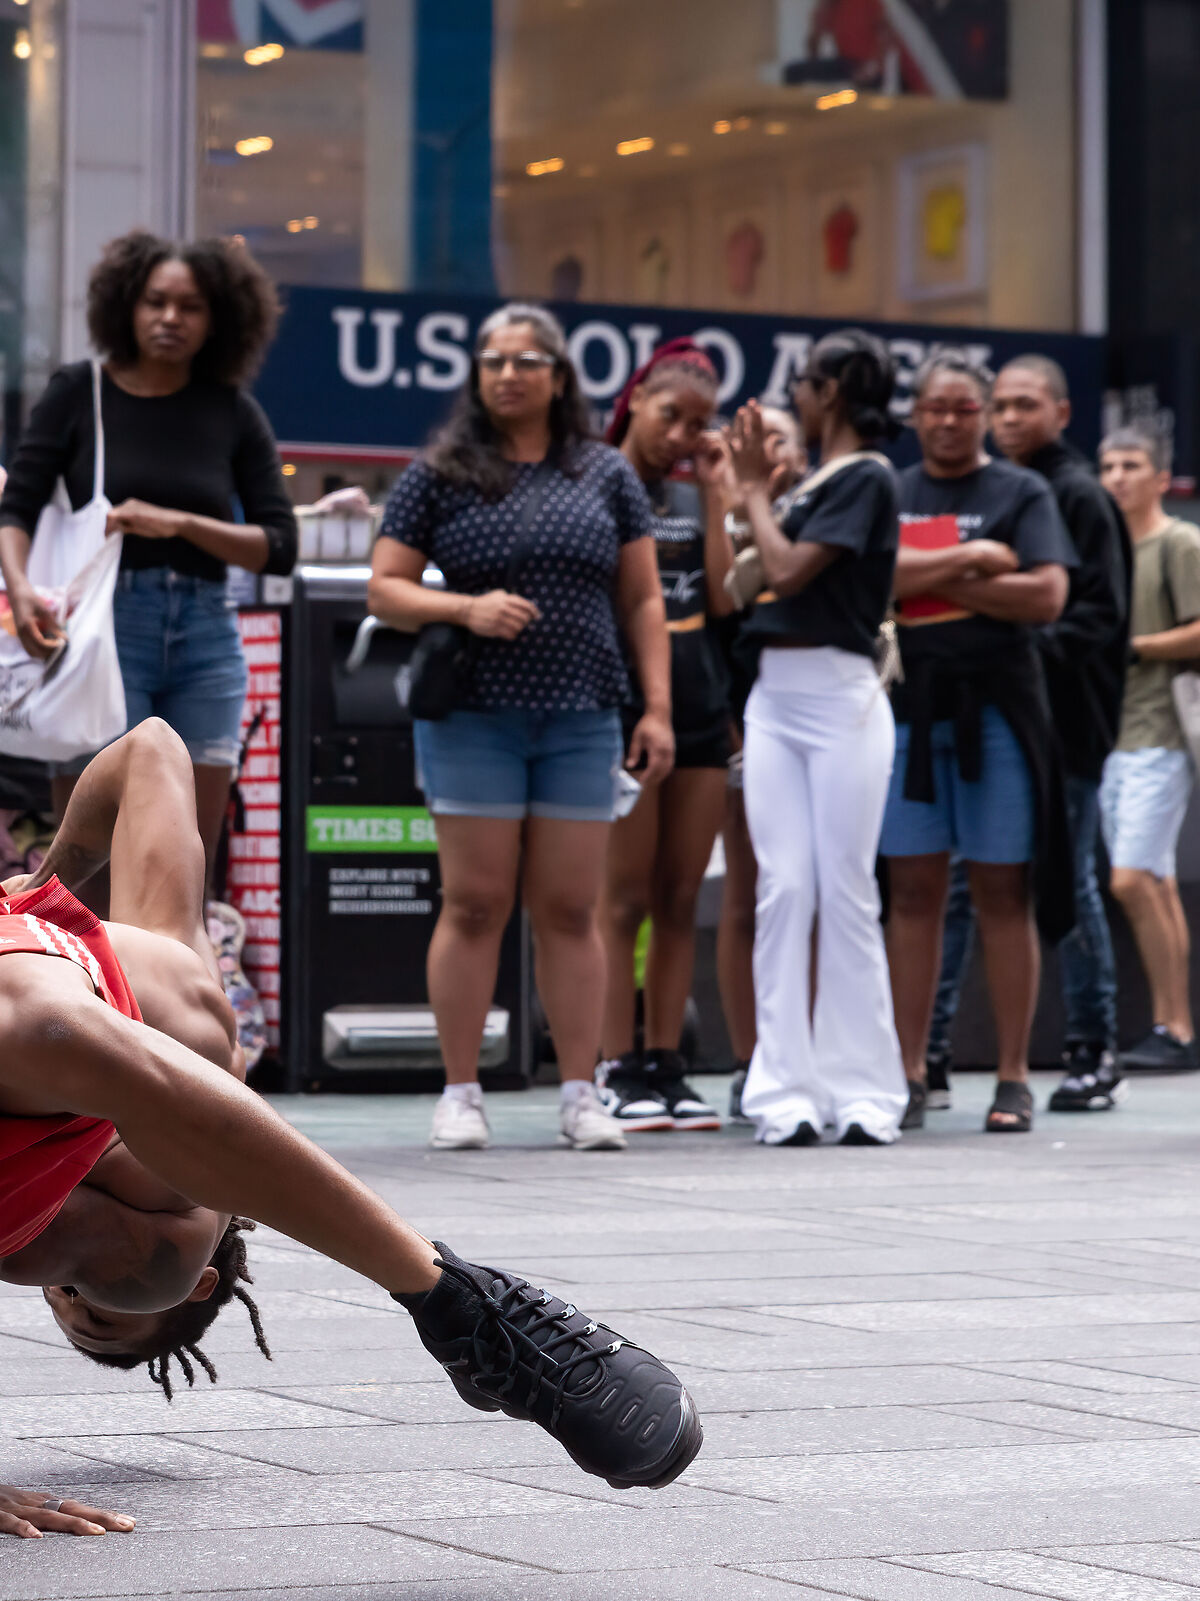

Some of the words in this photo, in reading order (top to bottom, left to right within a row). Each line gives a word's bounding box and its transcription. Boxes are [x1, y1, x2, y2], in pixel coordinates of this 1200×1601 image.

[332, 307, 472, 391] U.S
[566, 320, 746, 408] OO
[313, 818, 403, 842] TIMES
